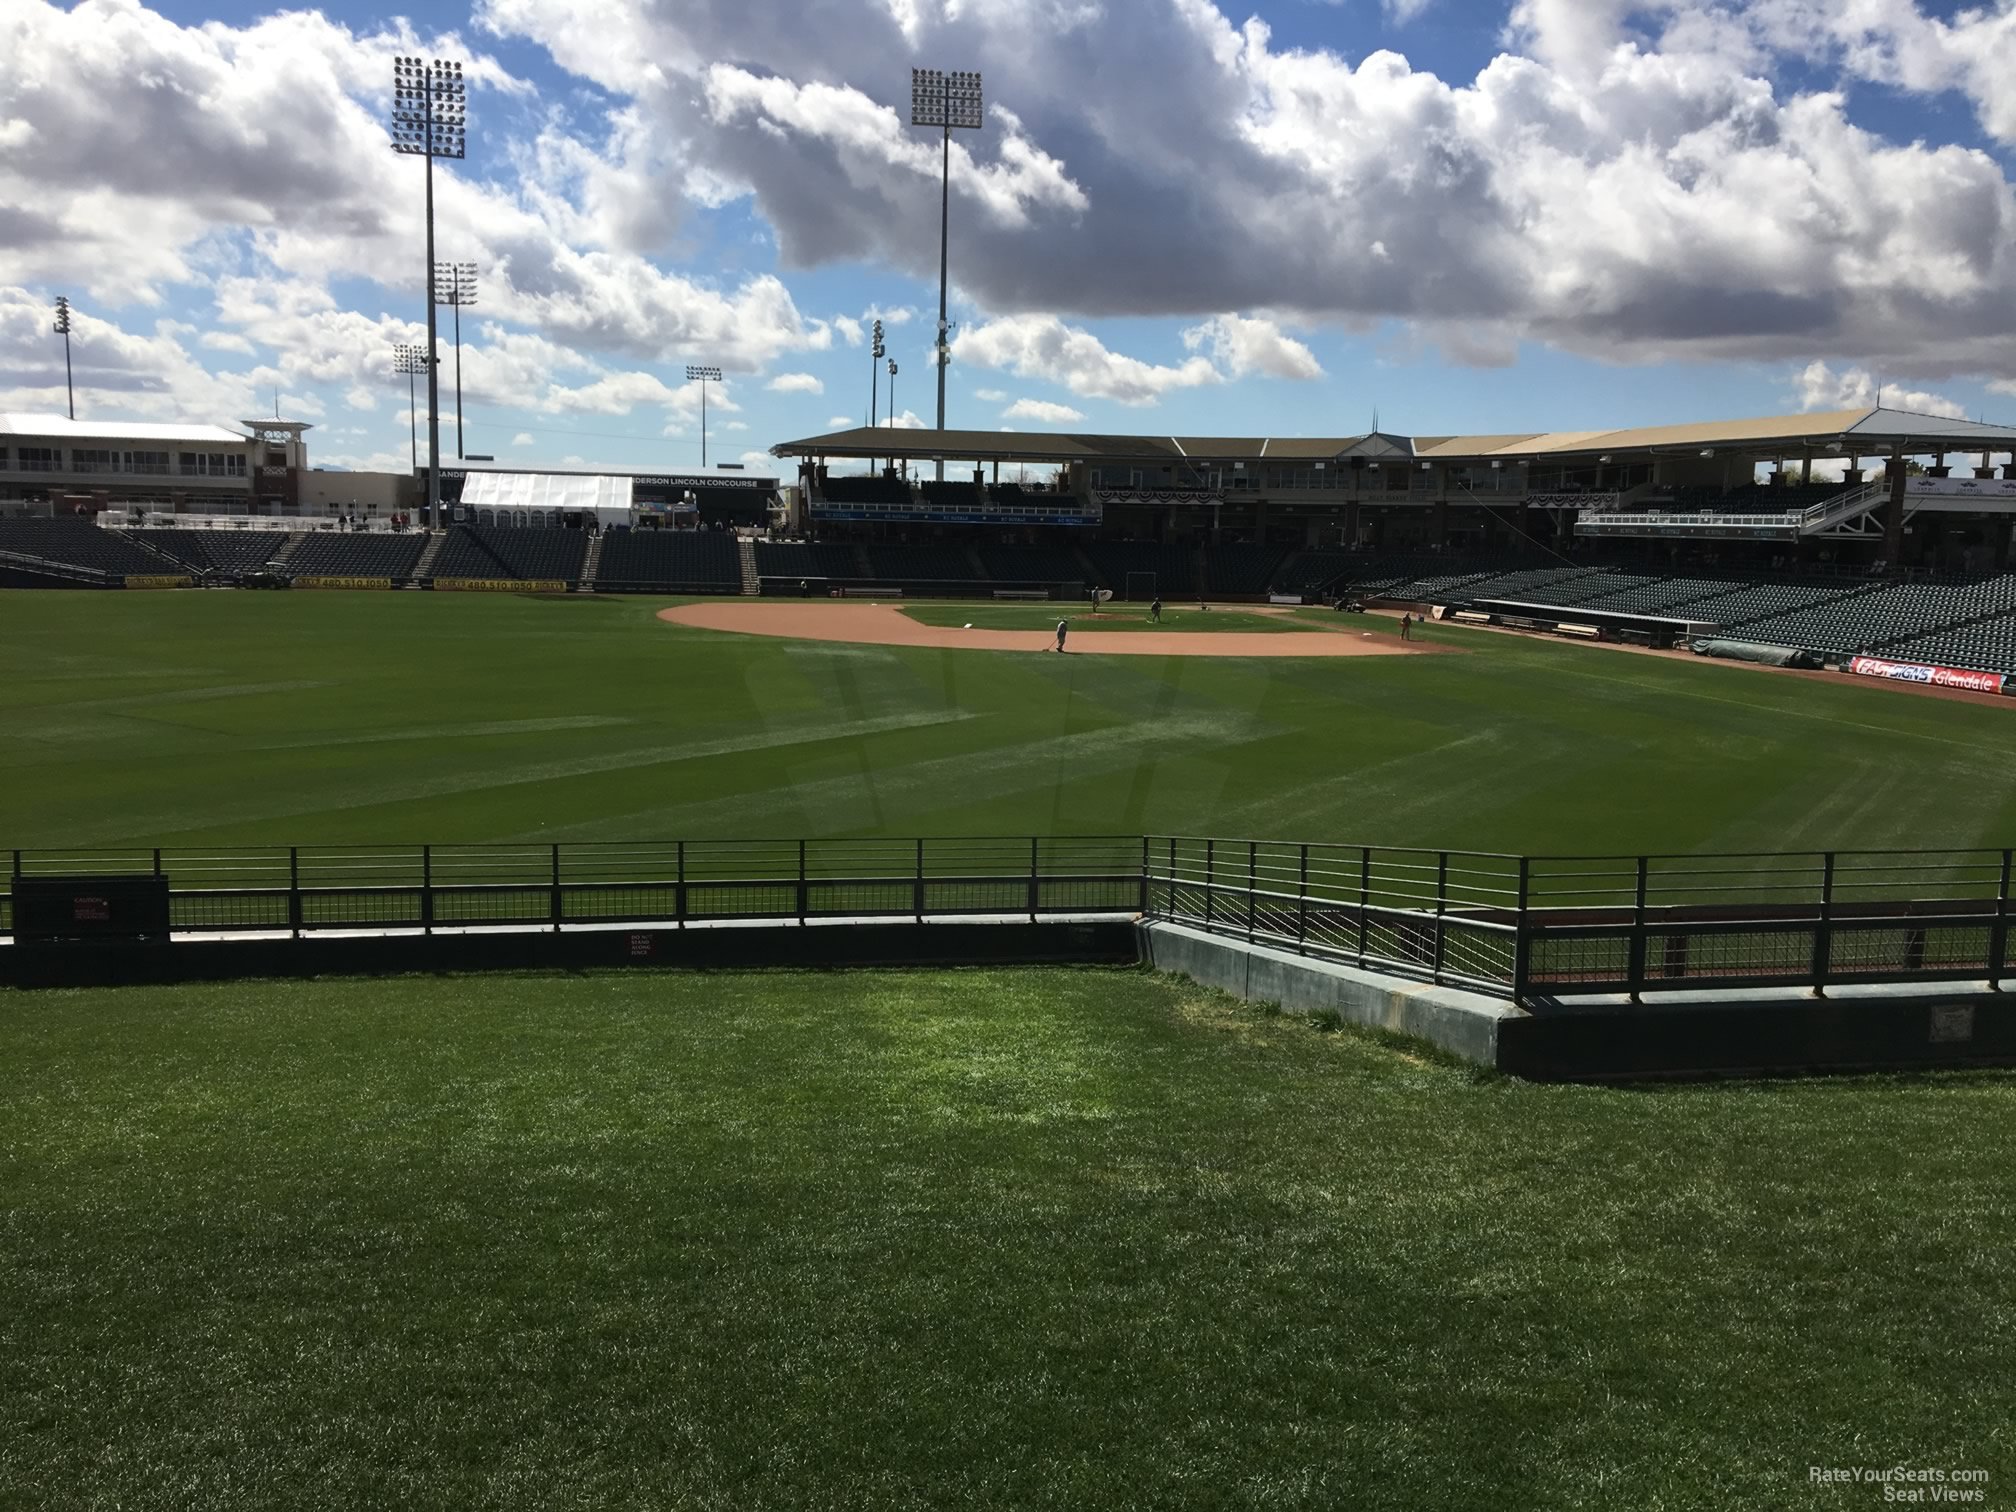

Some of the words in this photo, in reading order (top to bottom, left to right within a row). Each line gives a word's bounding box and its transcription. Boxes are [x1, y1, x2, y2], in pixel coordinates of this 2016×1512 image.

[670, 478, 705, 486] LINCOLN
[707, 479, 757, 488] CONCOURSE
[323, 579, 388, 587] 480.510.1050
[468, 581, 532, 590] 480.510.1050
[1859, 661, 1931, 681] FASTSIGNS
[1935, 671, 1993, 691] Glendale
